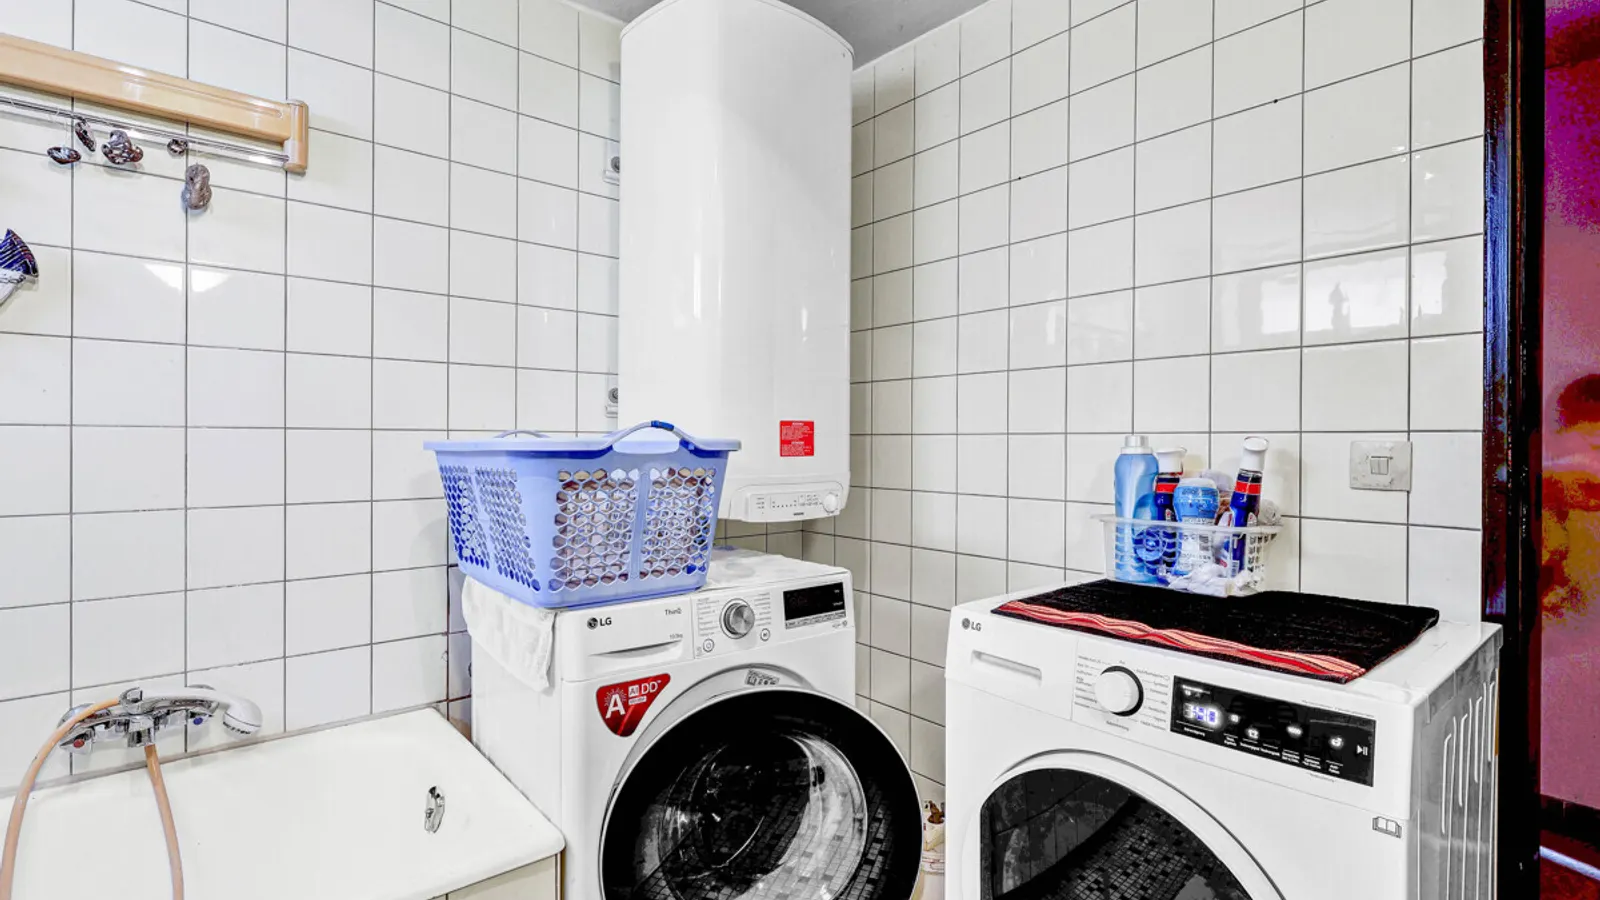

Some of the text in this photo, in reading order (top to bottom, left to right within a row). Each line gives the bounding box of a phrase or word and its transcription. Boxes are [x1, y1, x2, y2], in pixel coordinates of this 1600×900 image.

[599, 617, 612, 627] LG
[970, 621, 982, 631] LG
[605, 693, 626, 719] A
